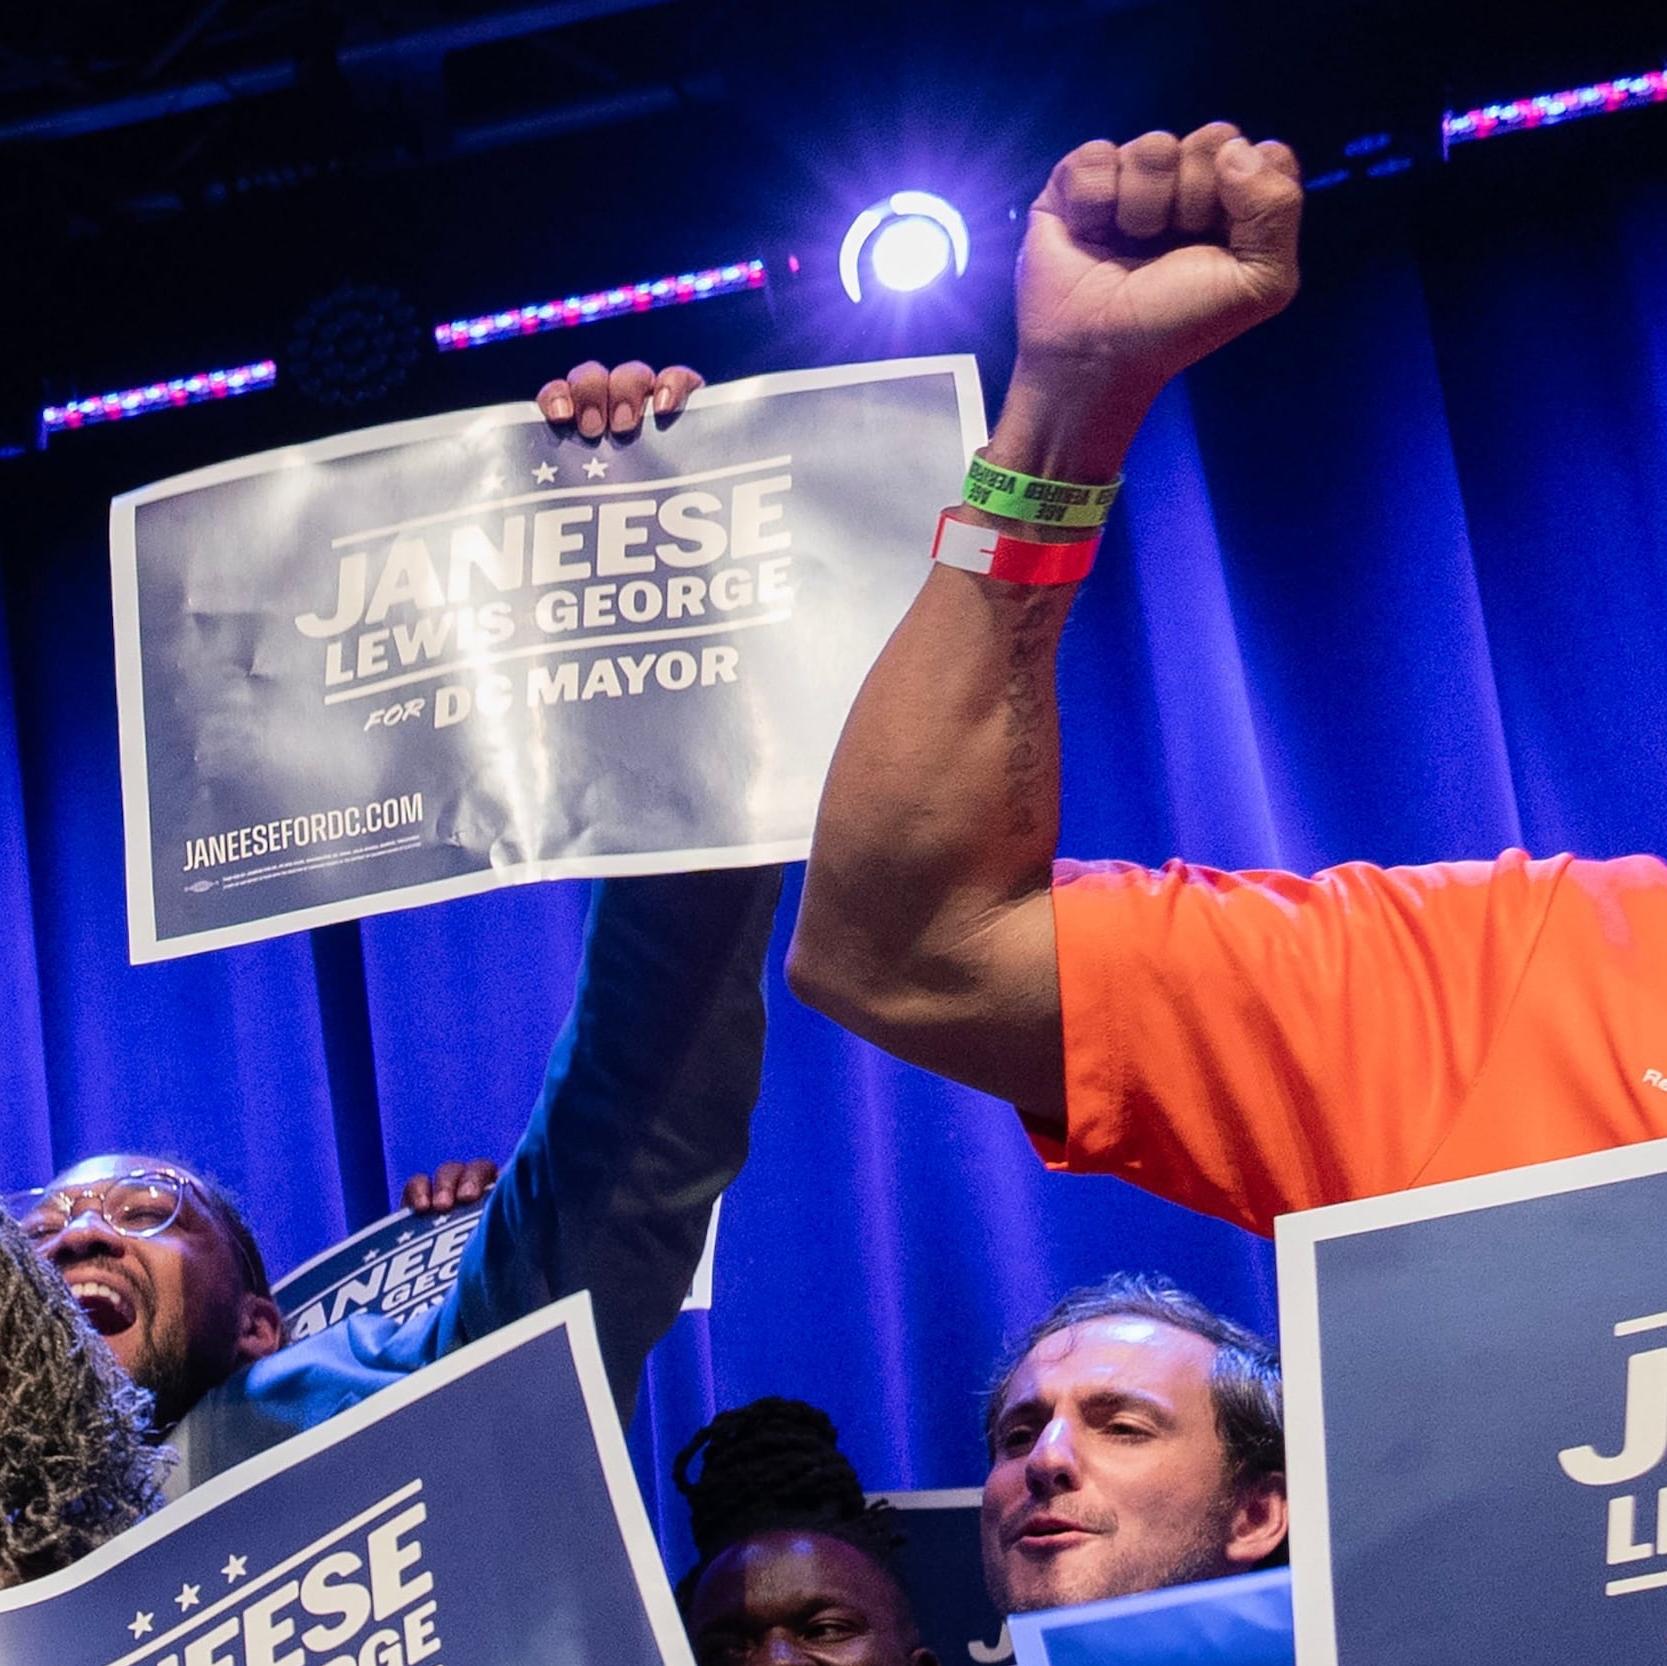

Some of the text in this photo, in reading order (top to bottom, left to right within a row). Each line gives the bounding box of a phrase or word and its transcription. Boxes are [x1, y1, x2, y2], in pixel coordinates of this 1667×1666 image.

[295, 474, 792, 639] JANEESE
[325, 556, 793, 686] LEWIS GEORGE
[364, 646, 739, 731] FOR DC MAYOR
[183, 792, 423, 872] JANEESEFORDC.COM
